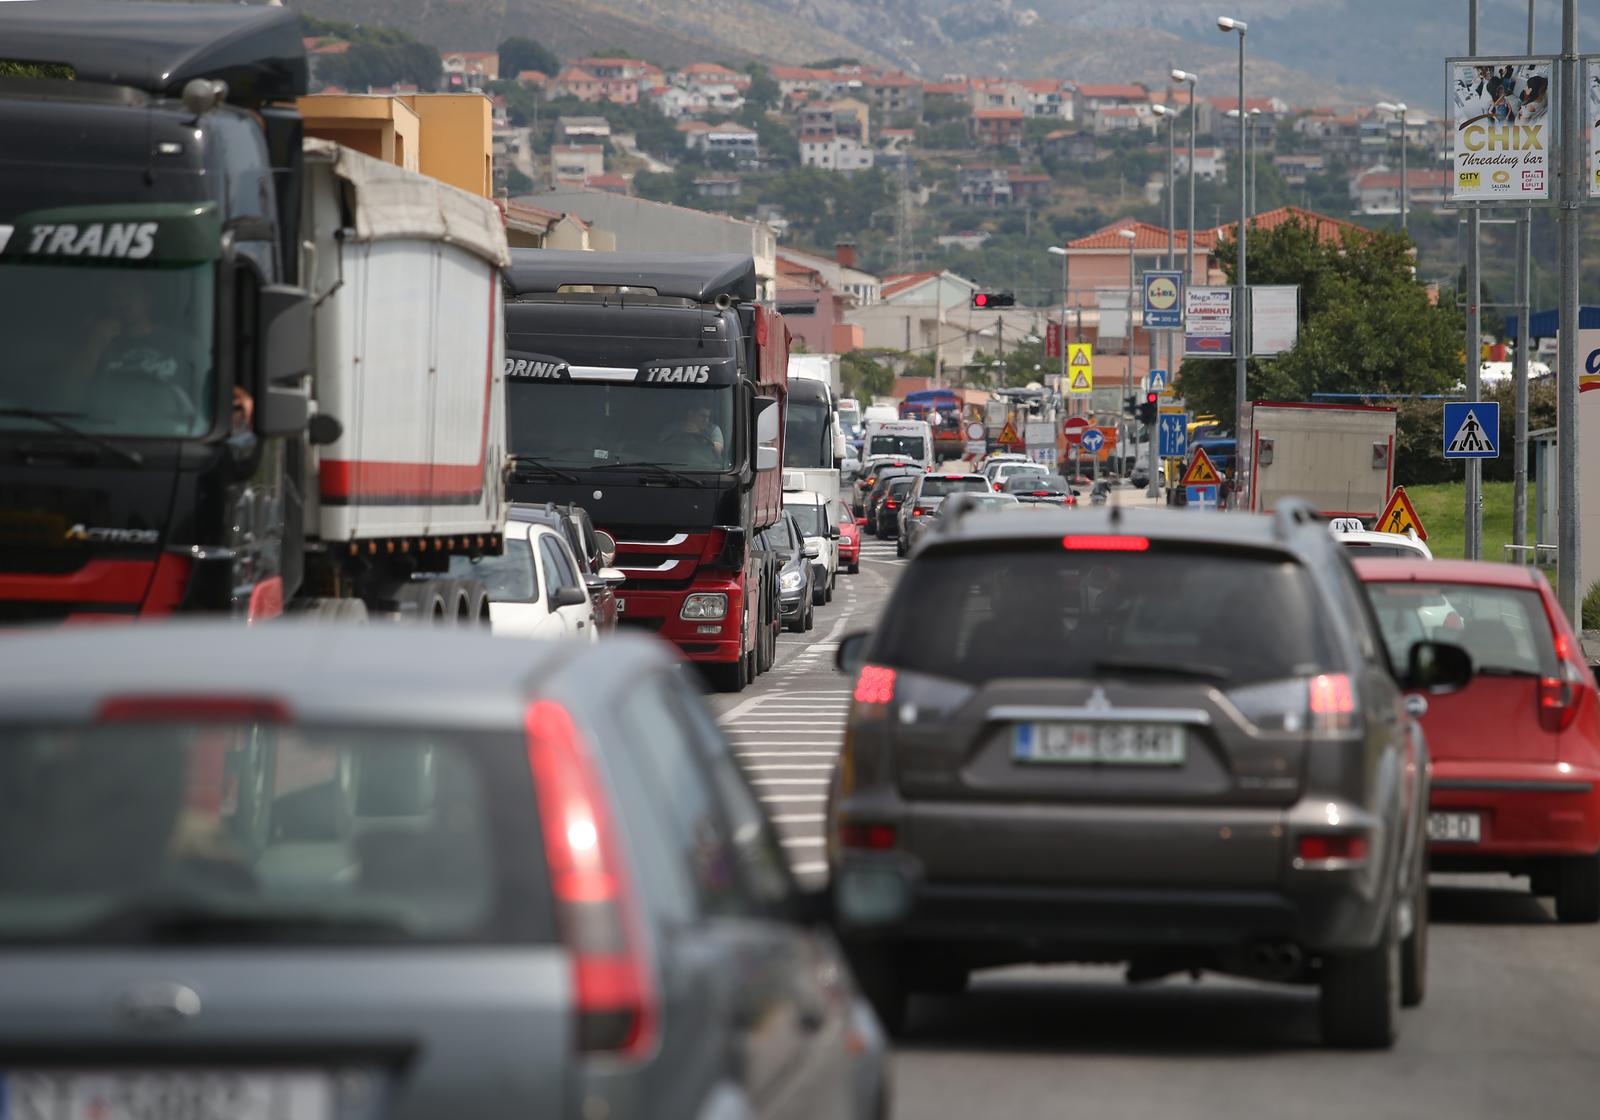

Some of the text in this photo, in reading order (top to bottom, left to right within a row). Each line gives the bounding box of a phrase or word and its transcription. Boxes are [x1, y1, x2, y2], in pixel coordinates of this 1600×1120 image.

[1463, 125, 1544, 151] CHIX
[1459, 152, 1543, 168] Threading bar
[1459, 172, 1478, 180] CITY
[28, 222, 160, 260] TRANS
[646, 365, 710, 384] TRANS
[1334, 521, 1358, 530] TAXI
